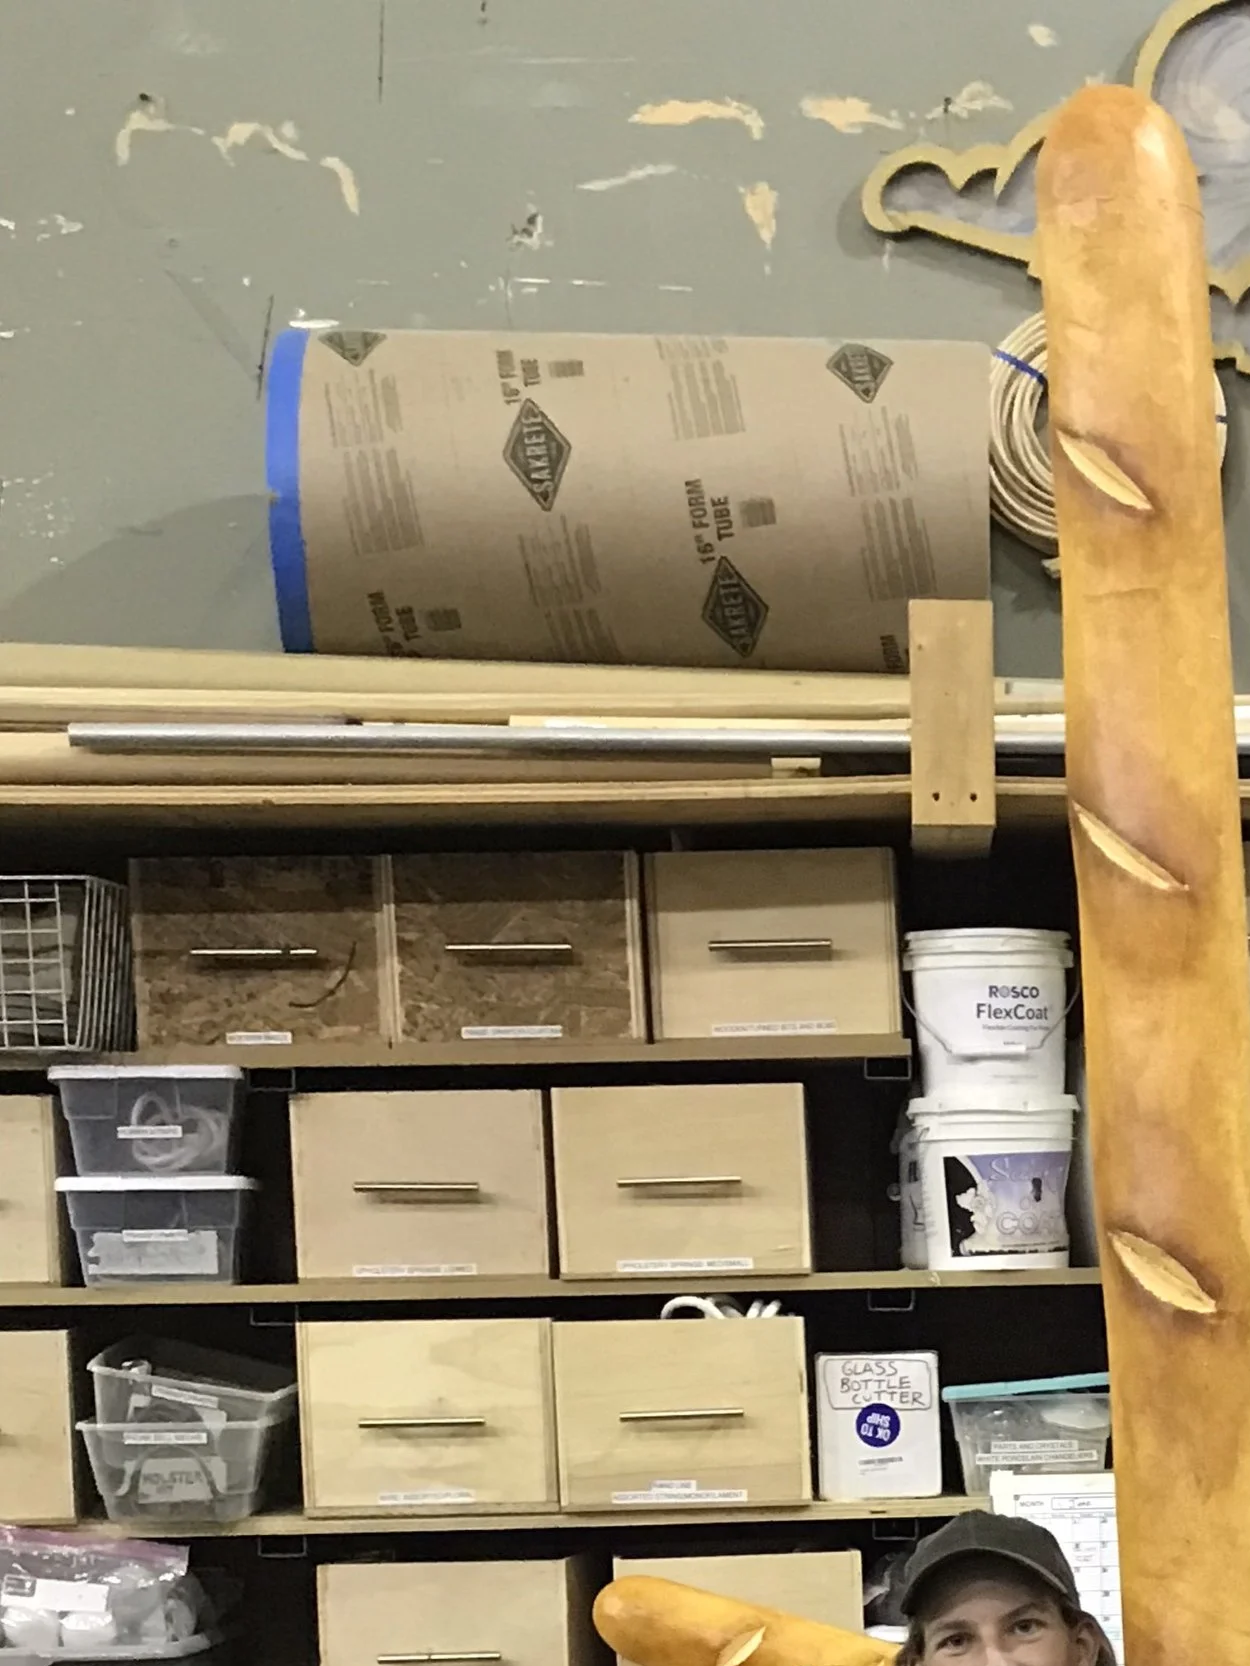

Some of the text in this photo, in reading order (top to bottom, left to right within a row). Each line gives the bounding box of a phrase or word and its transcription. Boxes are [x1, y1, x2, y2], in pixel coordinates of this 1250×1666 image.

[521, 415, 556, 494] SAKRETE
[684, 478, 711, 529] FORM
[711, 496, 735, 541] TUBE
[988, 985, 1040, 998] ROSCO
[976, 1003, 1049, 1020] FlexCoat
[841, 1361, 897, 1377] GLASS
[840, 1376, 911, 1394] BOTTLE
[851, 1391, 925, 1407] CUTTER
[866, 1412, 891, 1428] SHIP
[860, 1423, 891, 1441] OK TO
